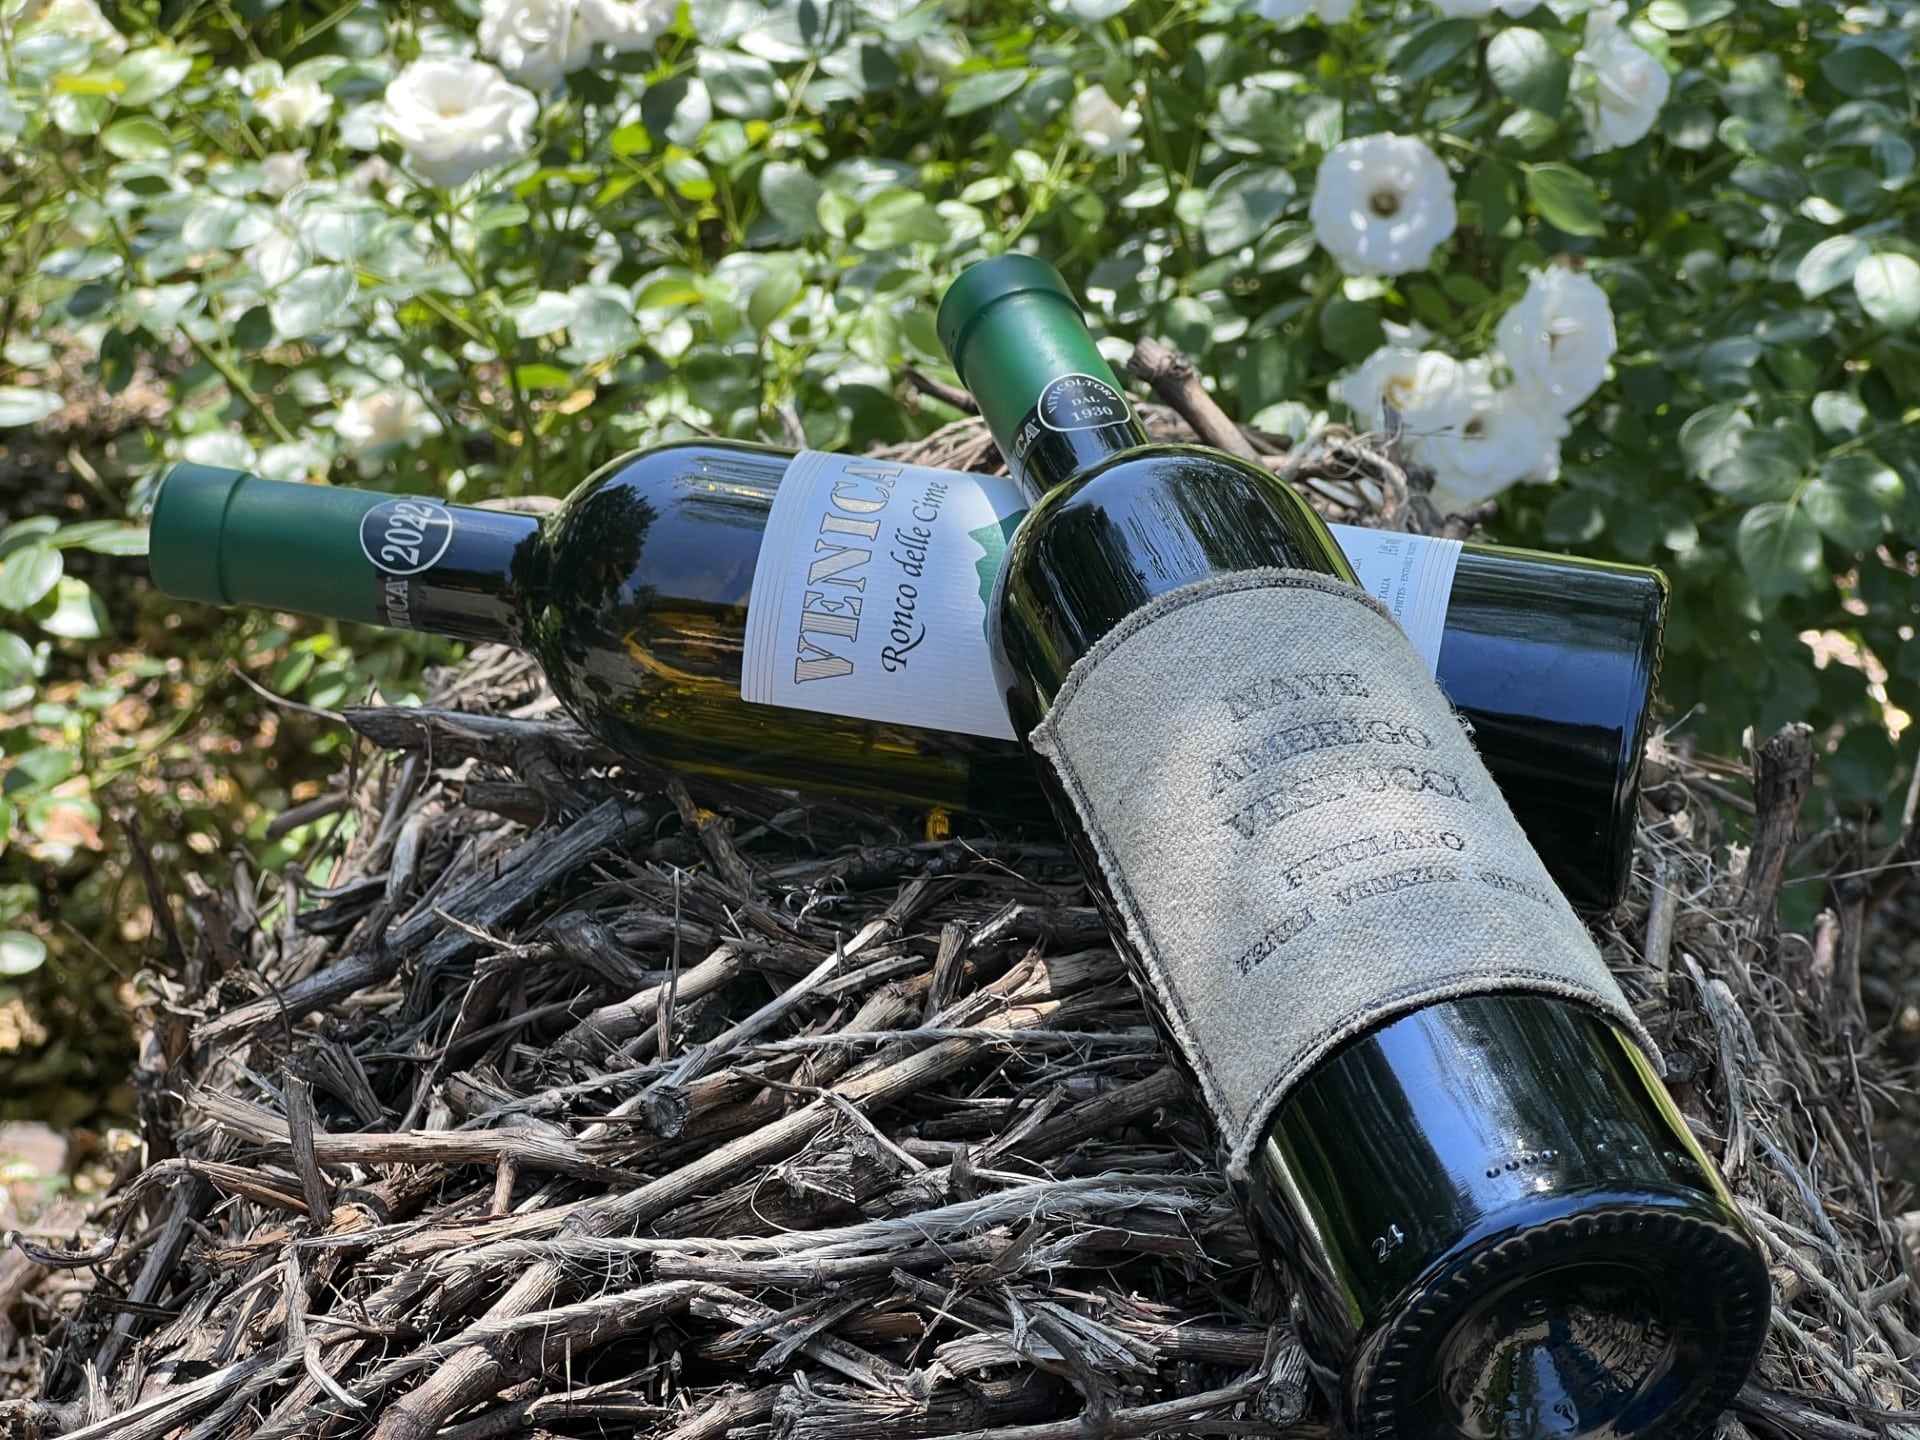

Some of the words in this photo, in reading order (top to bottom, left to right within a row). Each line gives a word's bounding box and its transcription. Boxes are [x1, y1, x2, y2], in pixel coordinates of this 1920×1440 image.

[1047, 378, 1117, 414] VITICOLTORI
[1071, 395, 1100, 407] DAL
[1071, 405, 1114, 422] 1930
[912, 480, 950, 523] Cime
[381, 502, 434, 566] 2022
[890, 527, 932, 577] delle
[794, 465, 904, 685] VENICA
[881, 583, 926, 673] Ronco
[1223, 673, 1370, 723] NAVE
[1209, 718, 1432, 799] AMERIGO
[1221, 764, 1471, 840] VESPUCCI
[1281, 830, 1465, 892] FRIULANO
[1371, 1223, 1404, 1264] 24
